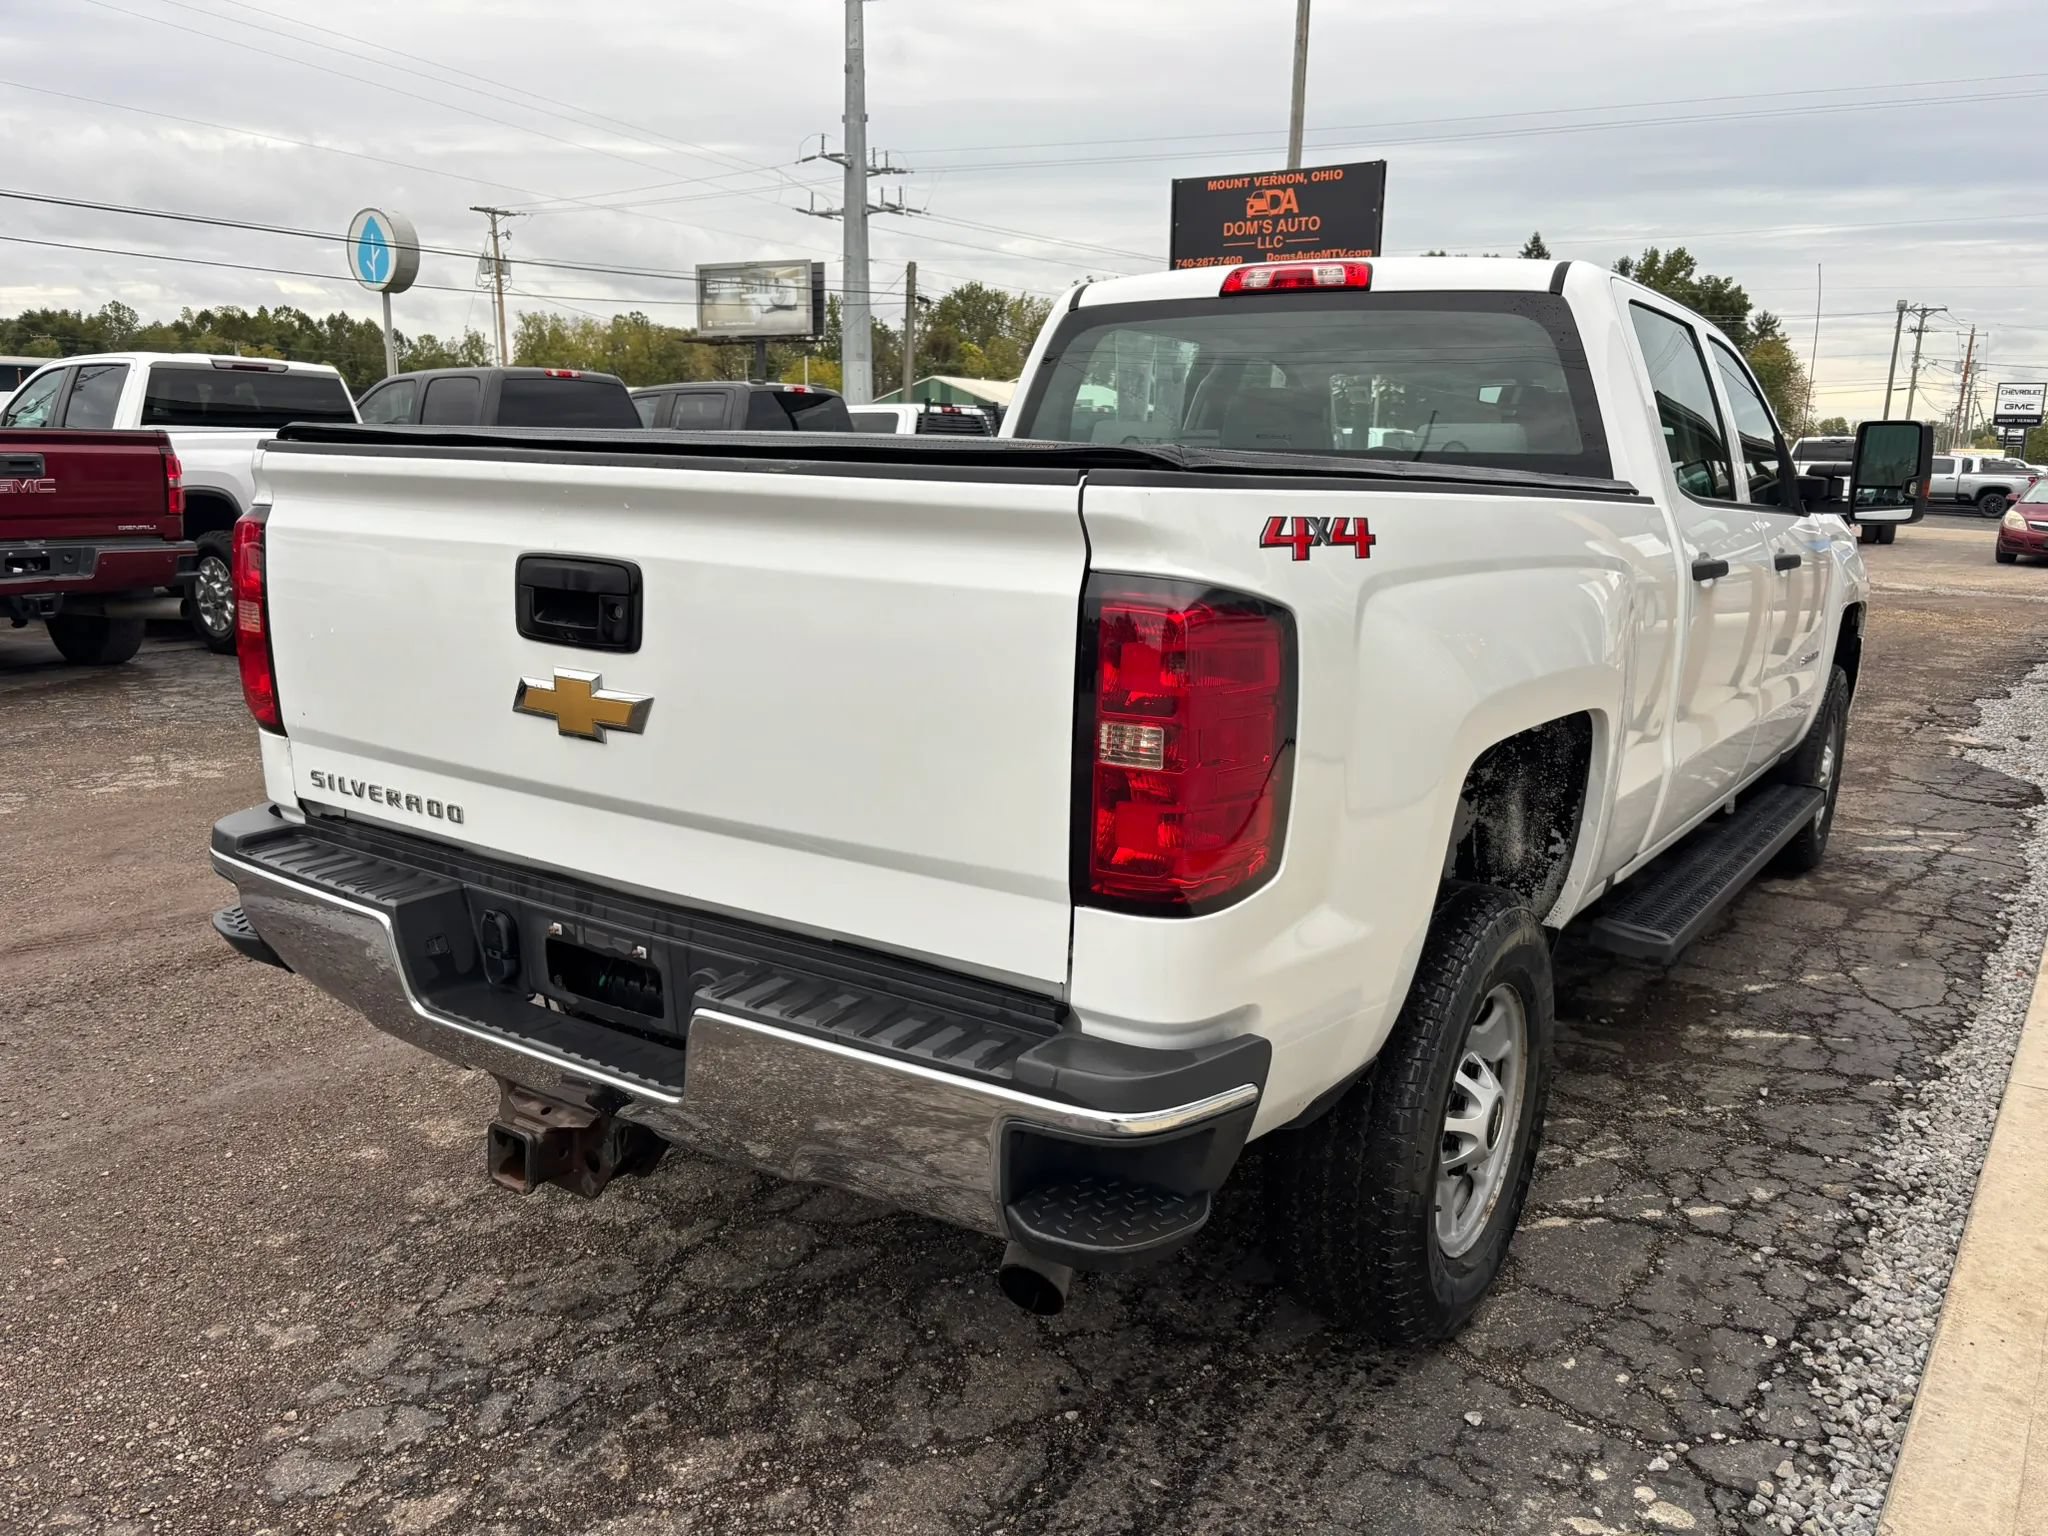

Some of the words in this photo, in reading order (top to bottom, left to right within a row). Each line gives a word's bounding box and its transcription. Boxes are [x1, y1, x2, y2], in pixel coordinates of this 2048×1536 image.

[1207, 177, 1250, 191] MOUNT
[1254, 172, 1308, 187] VERNON,
[1311, 169, 1344, 182] OHIO
[1223, 219, 1273, 237] DOM'S
[1276, 216, 1321, 233] AUTO
[1257, 235, 1284, 249] LLC
[1175, 256, 1243, 269] 740-287-7400
[1266, 248, 1372, 262] DomsAutoMTV.com
[310, 769, 464, 825] SILVERADO
